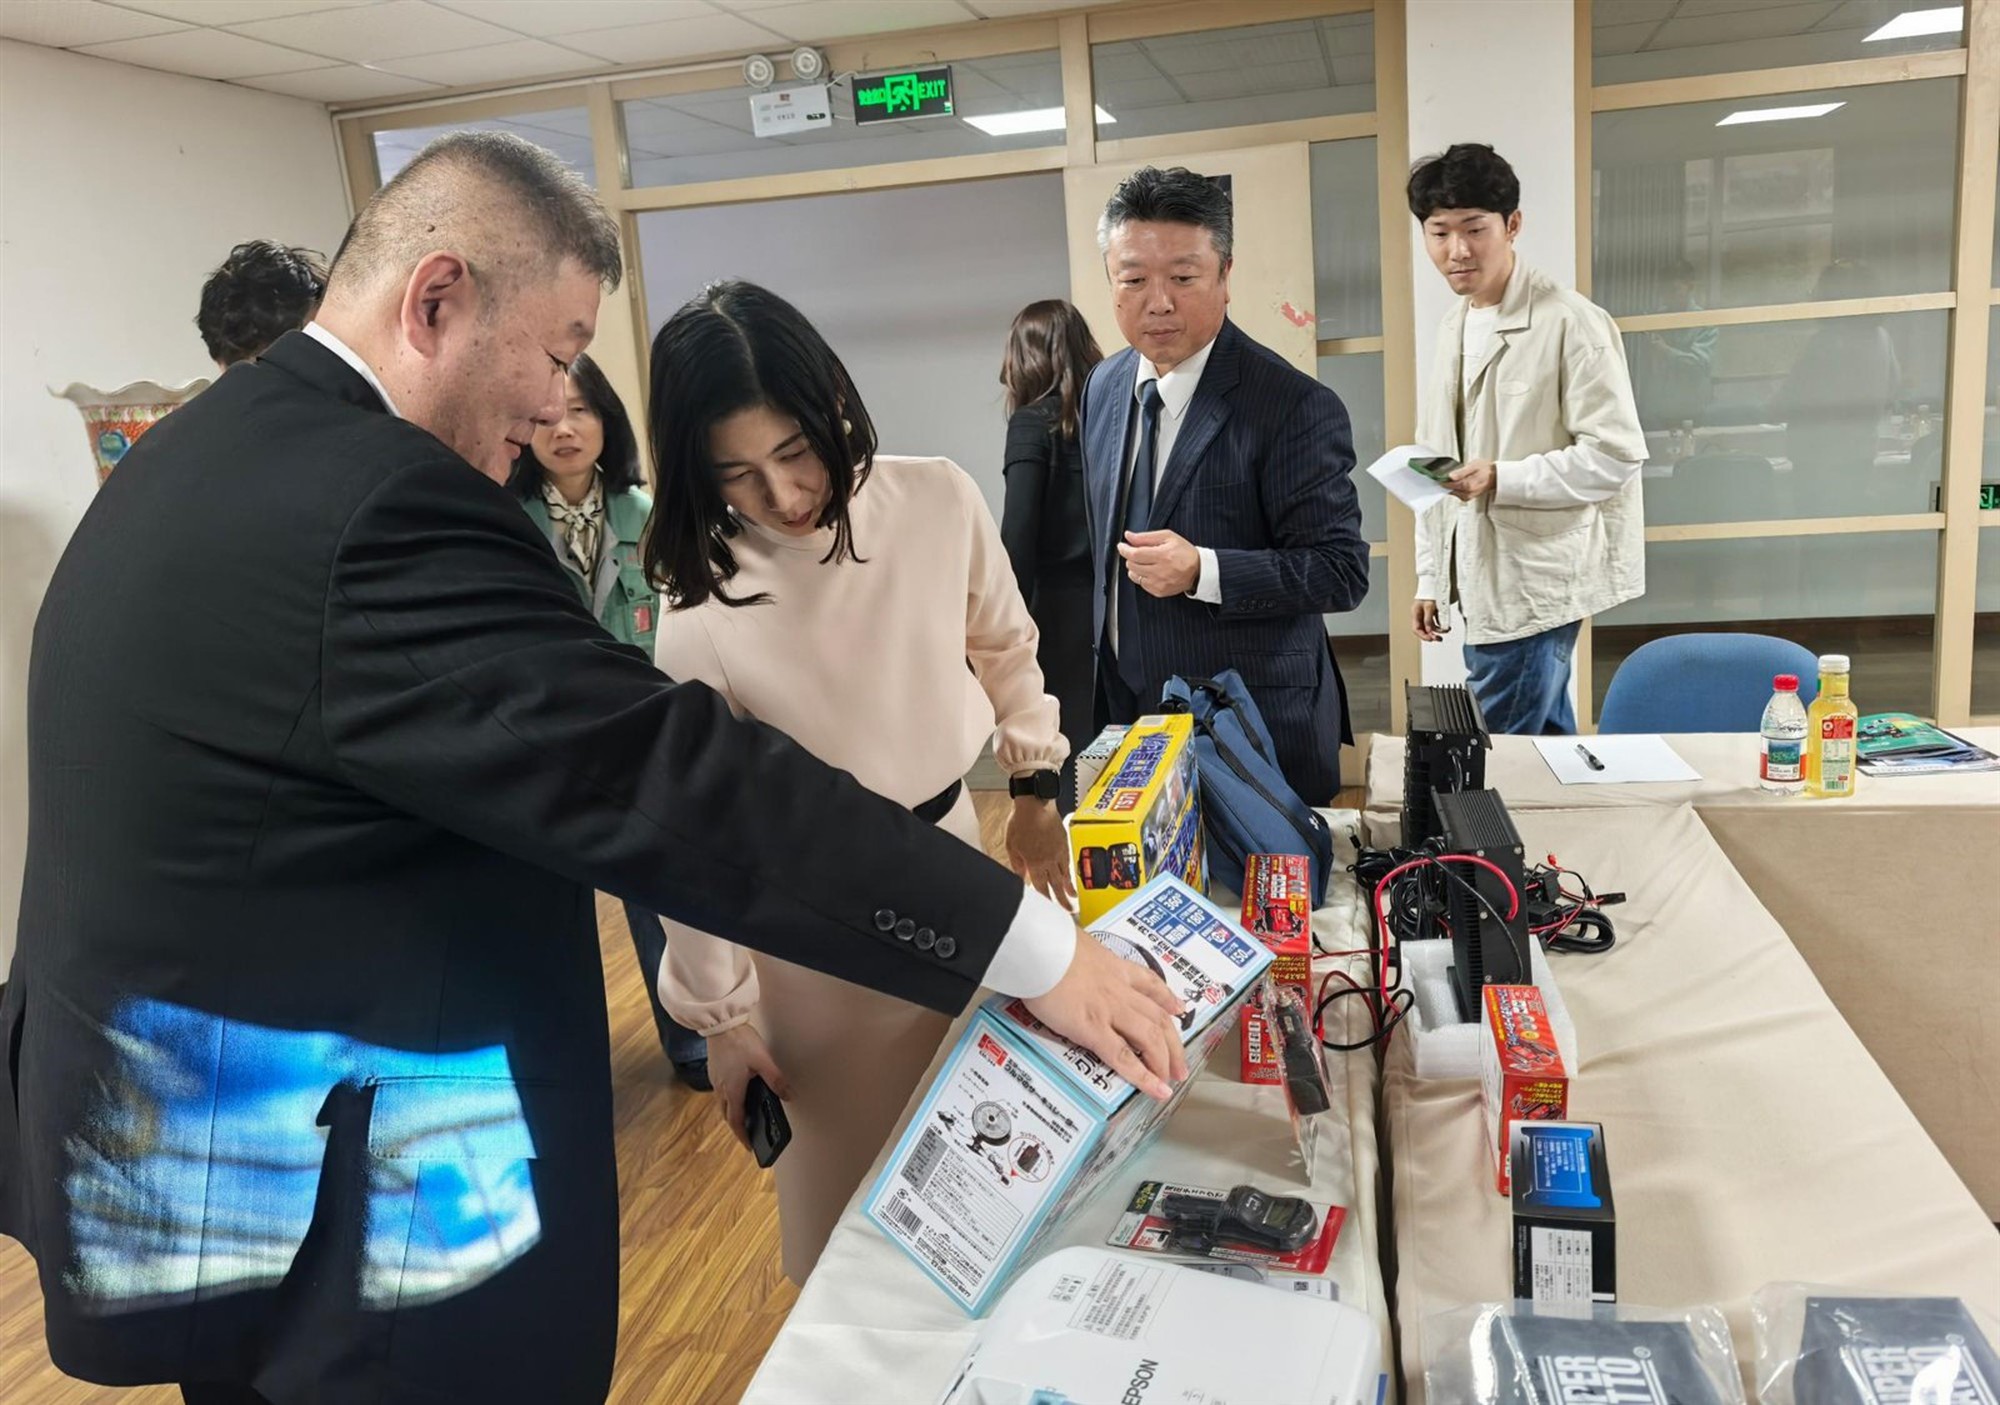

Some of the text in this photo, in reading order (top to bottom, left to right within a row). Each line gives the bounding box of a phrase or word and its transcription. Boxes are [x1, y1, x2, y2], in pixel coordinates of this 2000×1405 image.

[918, 79, 946, 100] EXIT
[1121, 1358, 1158, 1405] EPSON
[1555, 1355, 1610, 1405] PER
